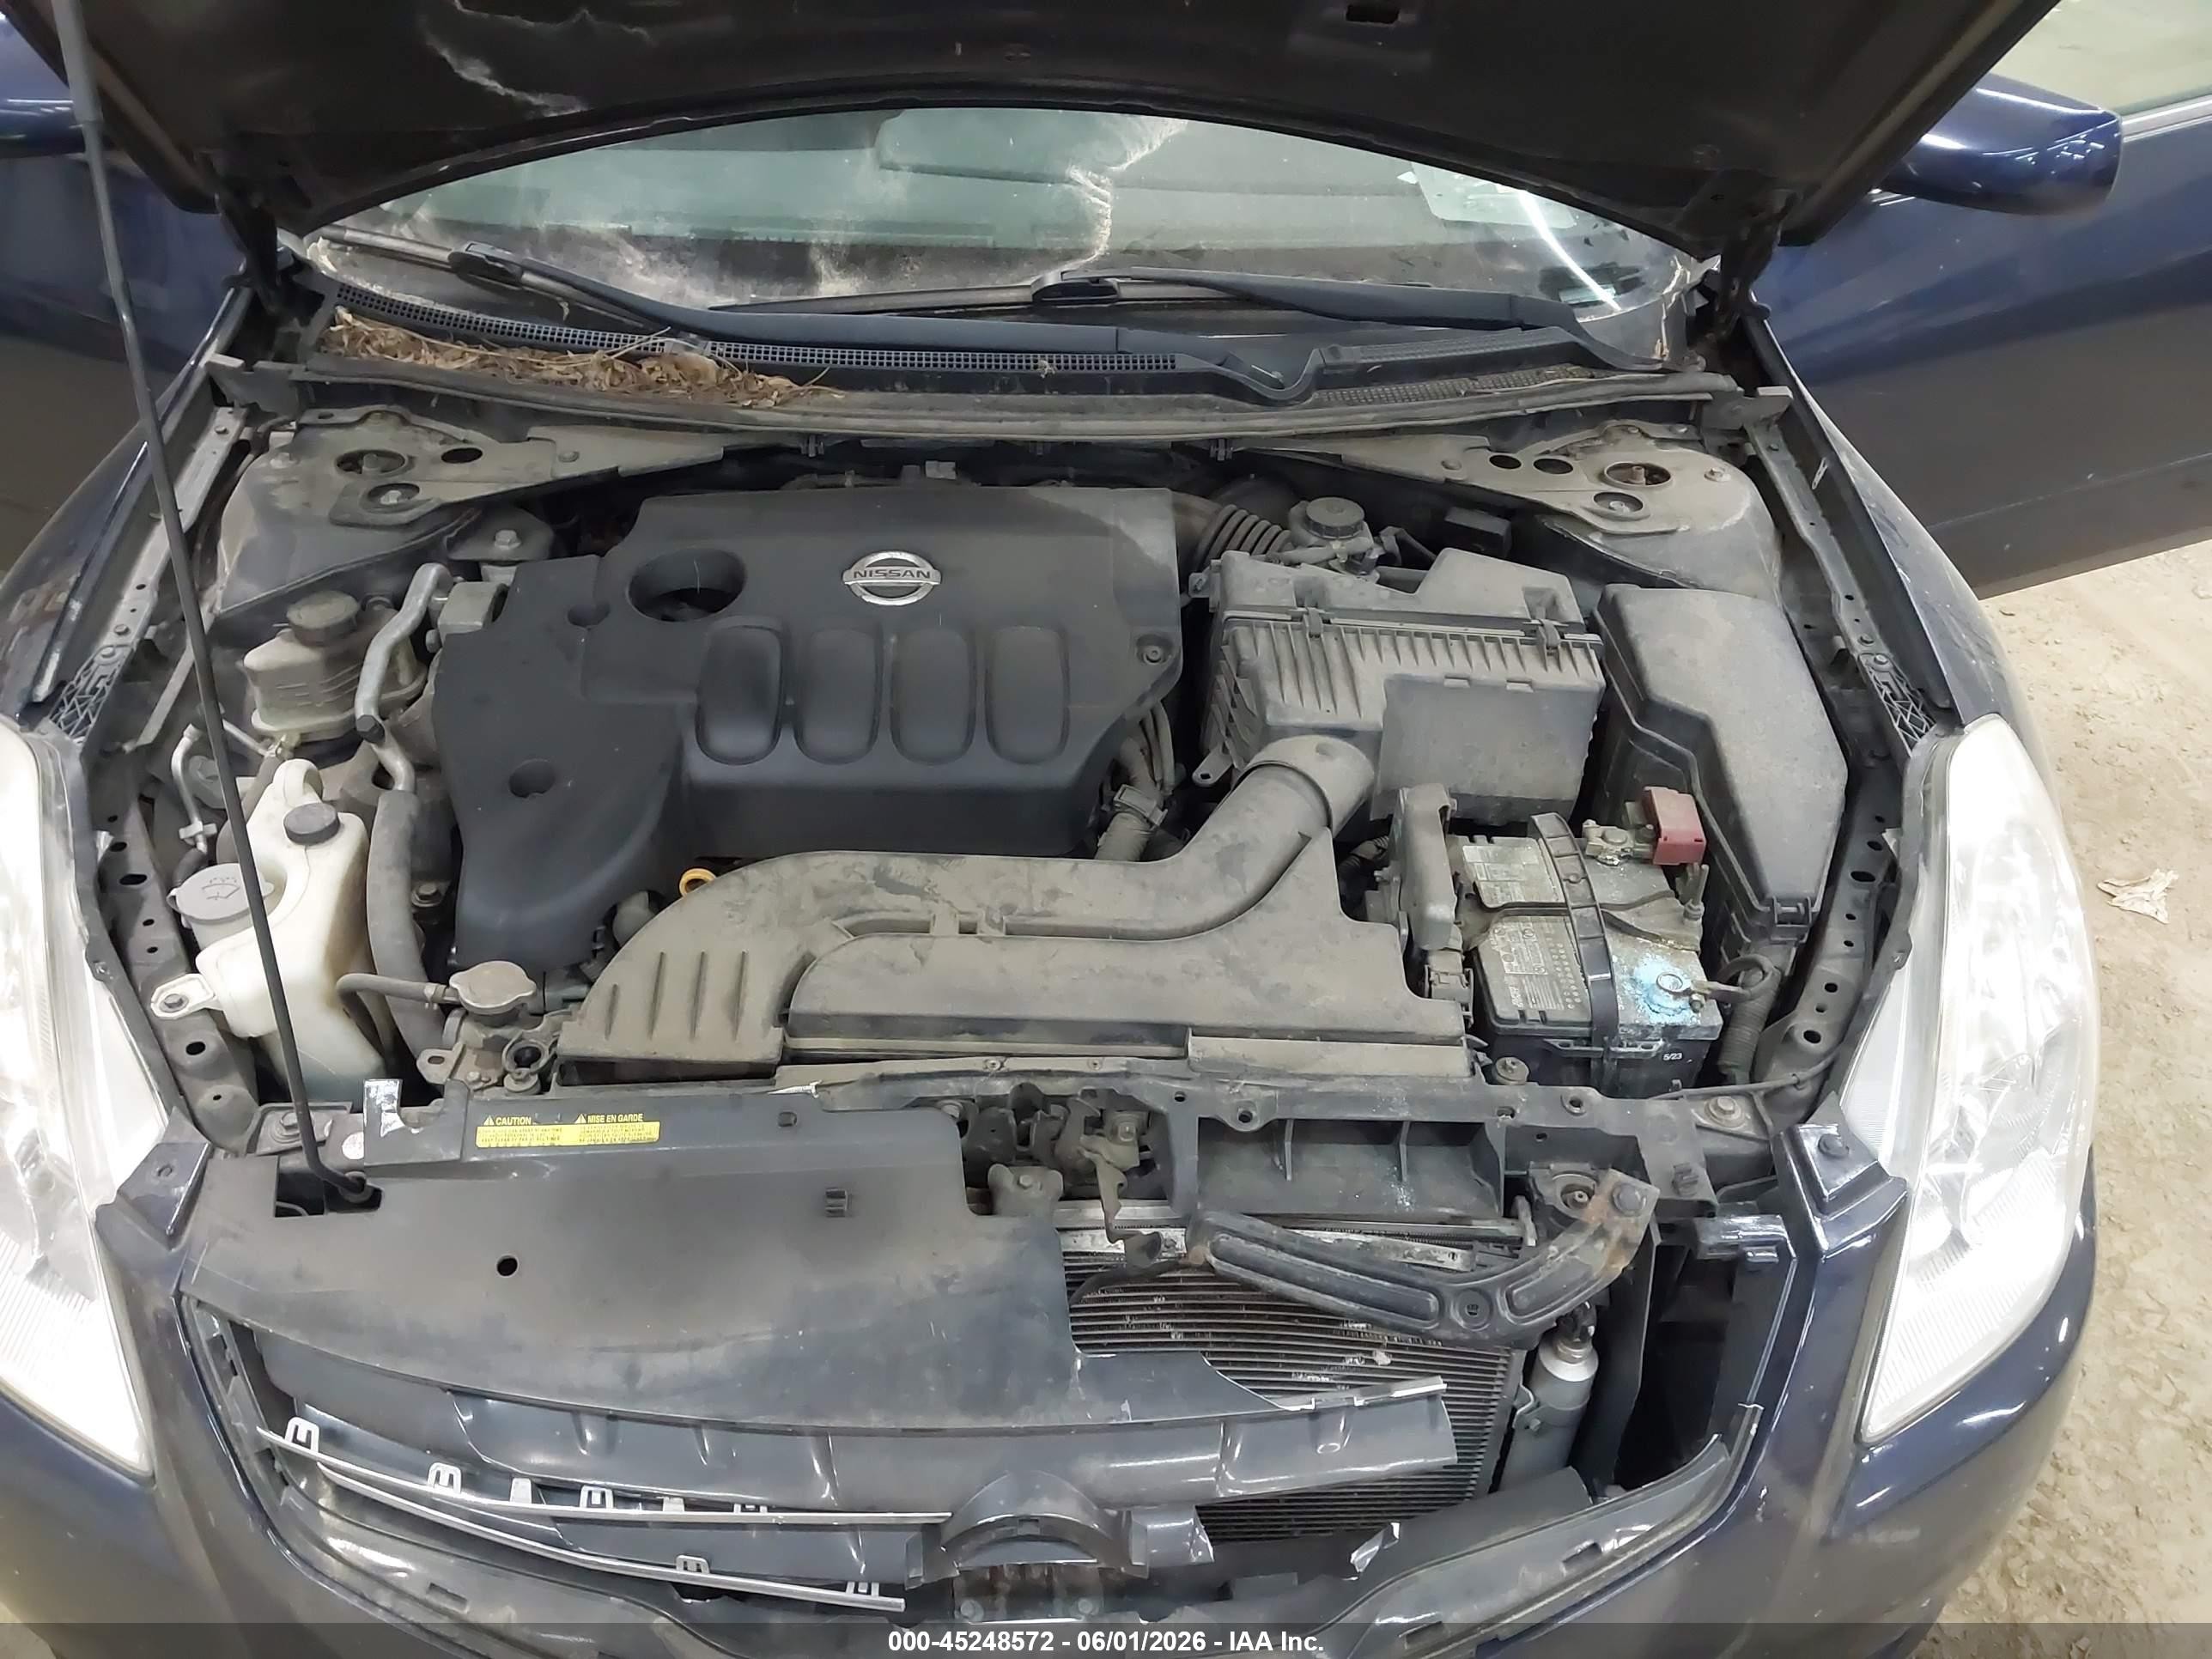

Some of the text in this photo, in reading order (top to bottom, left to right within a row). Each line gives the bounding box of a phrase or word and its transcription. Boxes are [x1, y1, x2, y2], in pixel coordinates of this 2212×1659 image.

[854, 568, 930, 579] NISSAN
[495, 1116, 532, 1126] CAUTION
[587, 1113, 643, 1124] MISE EN GARDE
